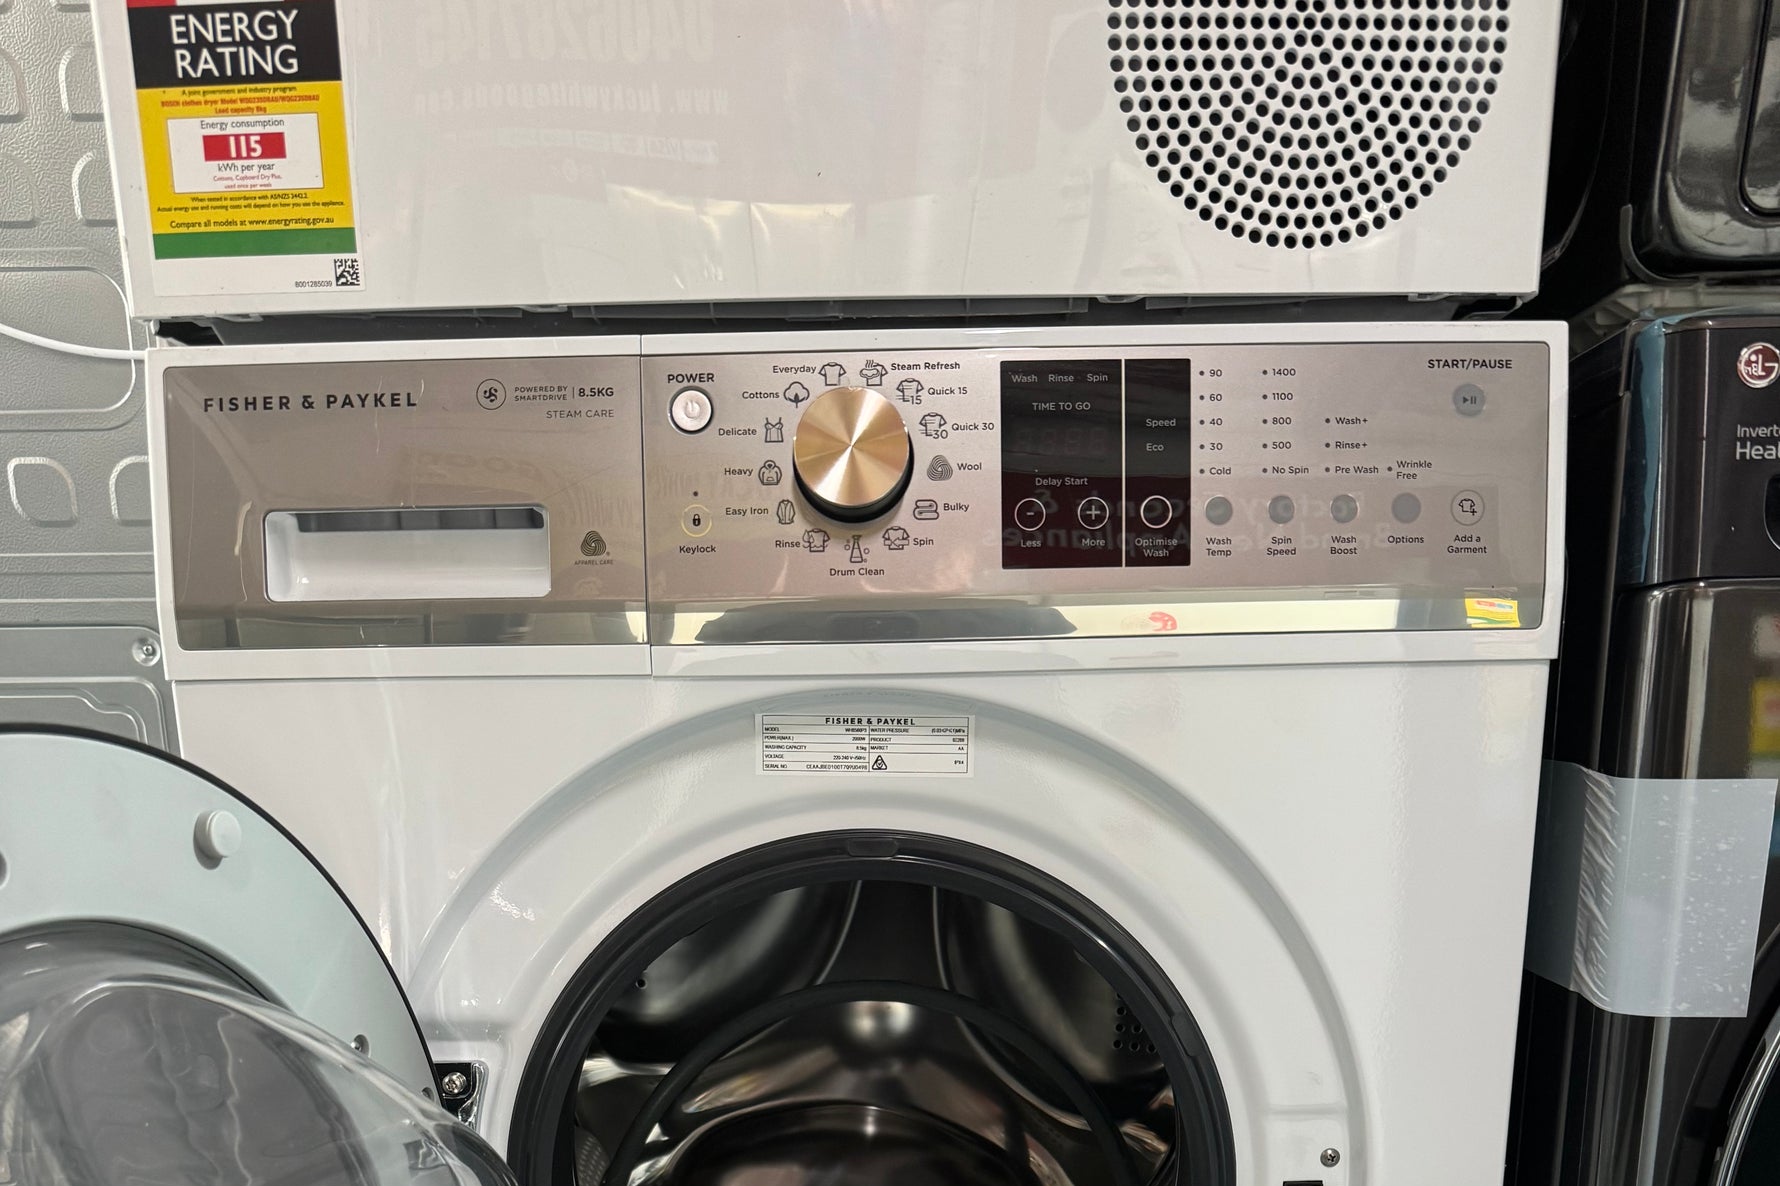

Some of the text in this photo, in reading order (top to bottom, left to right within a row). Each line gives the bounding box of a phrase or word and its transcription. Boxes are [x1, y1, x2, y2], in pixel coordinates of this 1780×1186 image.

[170, 9, 299, 44] ENERGY
[174, 45, 299, 79] RATING
[203, 88, 236, 96] government
[249, 87, 272, 95] industry
[201, 118, 284, 130] Energy consumption
[229, 136, 262, 157] 115
[218, 163, 275, 174] kWh per year
[170, 221, 201, 229] Compare
[213, 218, 238, 226] models
[248, 217, 334, 226] www.energyrating.gov.au
[891, 361, 960, 371] Steam Refresh
[1427, 358, 1512, 370] START/PAUSE
[773, 365, 816, 375] Everyday
[1209, 369, 1222, 378] 90
[1272, 368, 1296, 377] 1400
[667, 372, 715, 384] POWER
[1011, 373, 1108, 384] Wash Rinse Spin
[579, 387, 614, 397] 8.5KG
[742, 391, 780, 399] Cottons
[928, 387, 967, 396] Quick 15
[911, 396, 922, 405] 15
[1209, 393, 1222, 402] 60
[1272, 393, 1293, 401] 1100
[204, 392, 417, 412] FISHER & PAYKEL
[1033, 402, 1090, 411] TIME TO GO
[546, 410, 614, 419] STEAM CARE
[1146, 418, 1176, 428] Speed
[1209, 417, 1223, 426] 40
[1272, 417, 1292, 425] 800
[1335, 416, 1368, 425] Wash+
[952, 422, 994, 431] Quick 30
[718, 427, 757, 436] Delicate
[933, 430, 948, 439] 30
[1146, 443, 1163, 451] Eco
[1209, 442, 1223, 451] 30
[1272, 441, 1292, 450] 500
[1335, 441, 1368, 450] Rinse+
[957, 462, 982, 471] Wool
[1397, 460, 1432, 469] Wrinkle
[725, 468, 753, 477] Heavy
[1209, 466, 1231, 476] Cold
[1272, 465, 1309, 476] No Spin
[1335, 465, 1379, 474] Pre Wash
[1397, 472, 1418, 480] Free
[1035, 477, 1088, 487] Delay Start
[725, 506, 769, 517] Easy Iron
[943, 502, 969, 512] Bulky
[913, 536, 933, 547] Spin
[1021, 539, 1041, 548] Less
[1082, 538, 1105, 546] More
[1135, 537, 1178, 548] Optimise
[1206, 537, 1232, 545] Wash
[1271, 536, 1292, 547] Spin
[1331, 535, 1357, 544] Wash
[1387, 535, 1424, 546] Options
[1454, 535, 1470, 543] Add
[775, 540, 800, 548] Rinse
[680, 545, 716, 554] Keylock
[1144, 549, 1169, 557] Wash
[1206, 548, 1232, 558] Temp
[1267, 547, 1296, 557] Speed
[1330, 547, 1357, 556] Boost
[1447, 545, 1487, 555] Garment
[829, 567, 884, 576] Drum Clean
